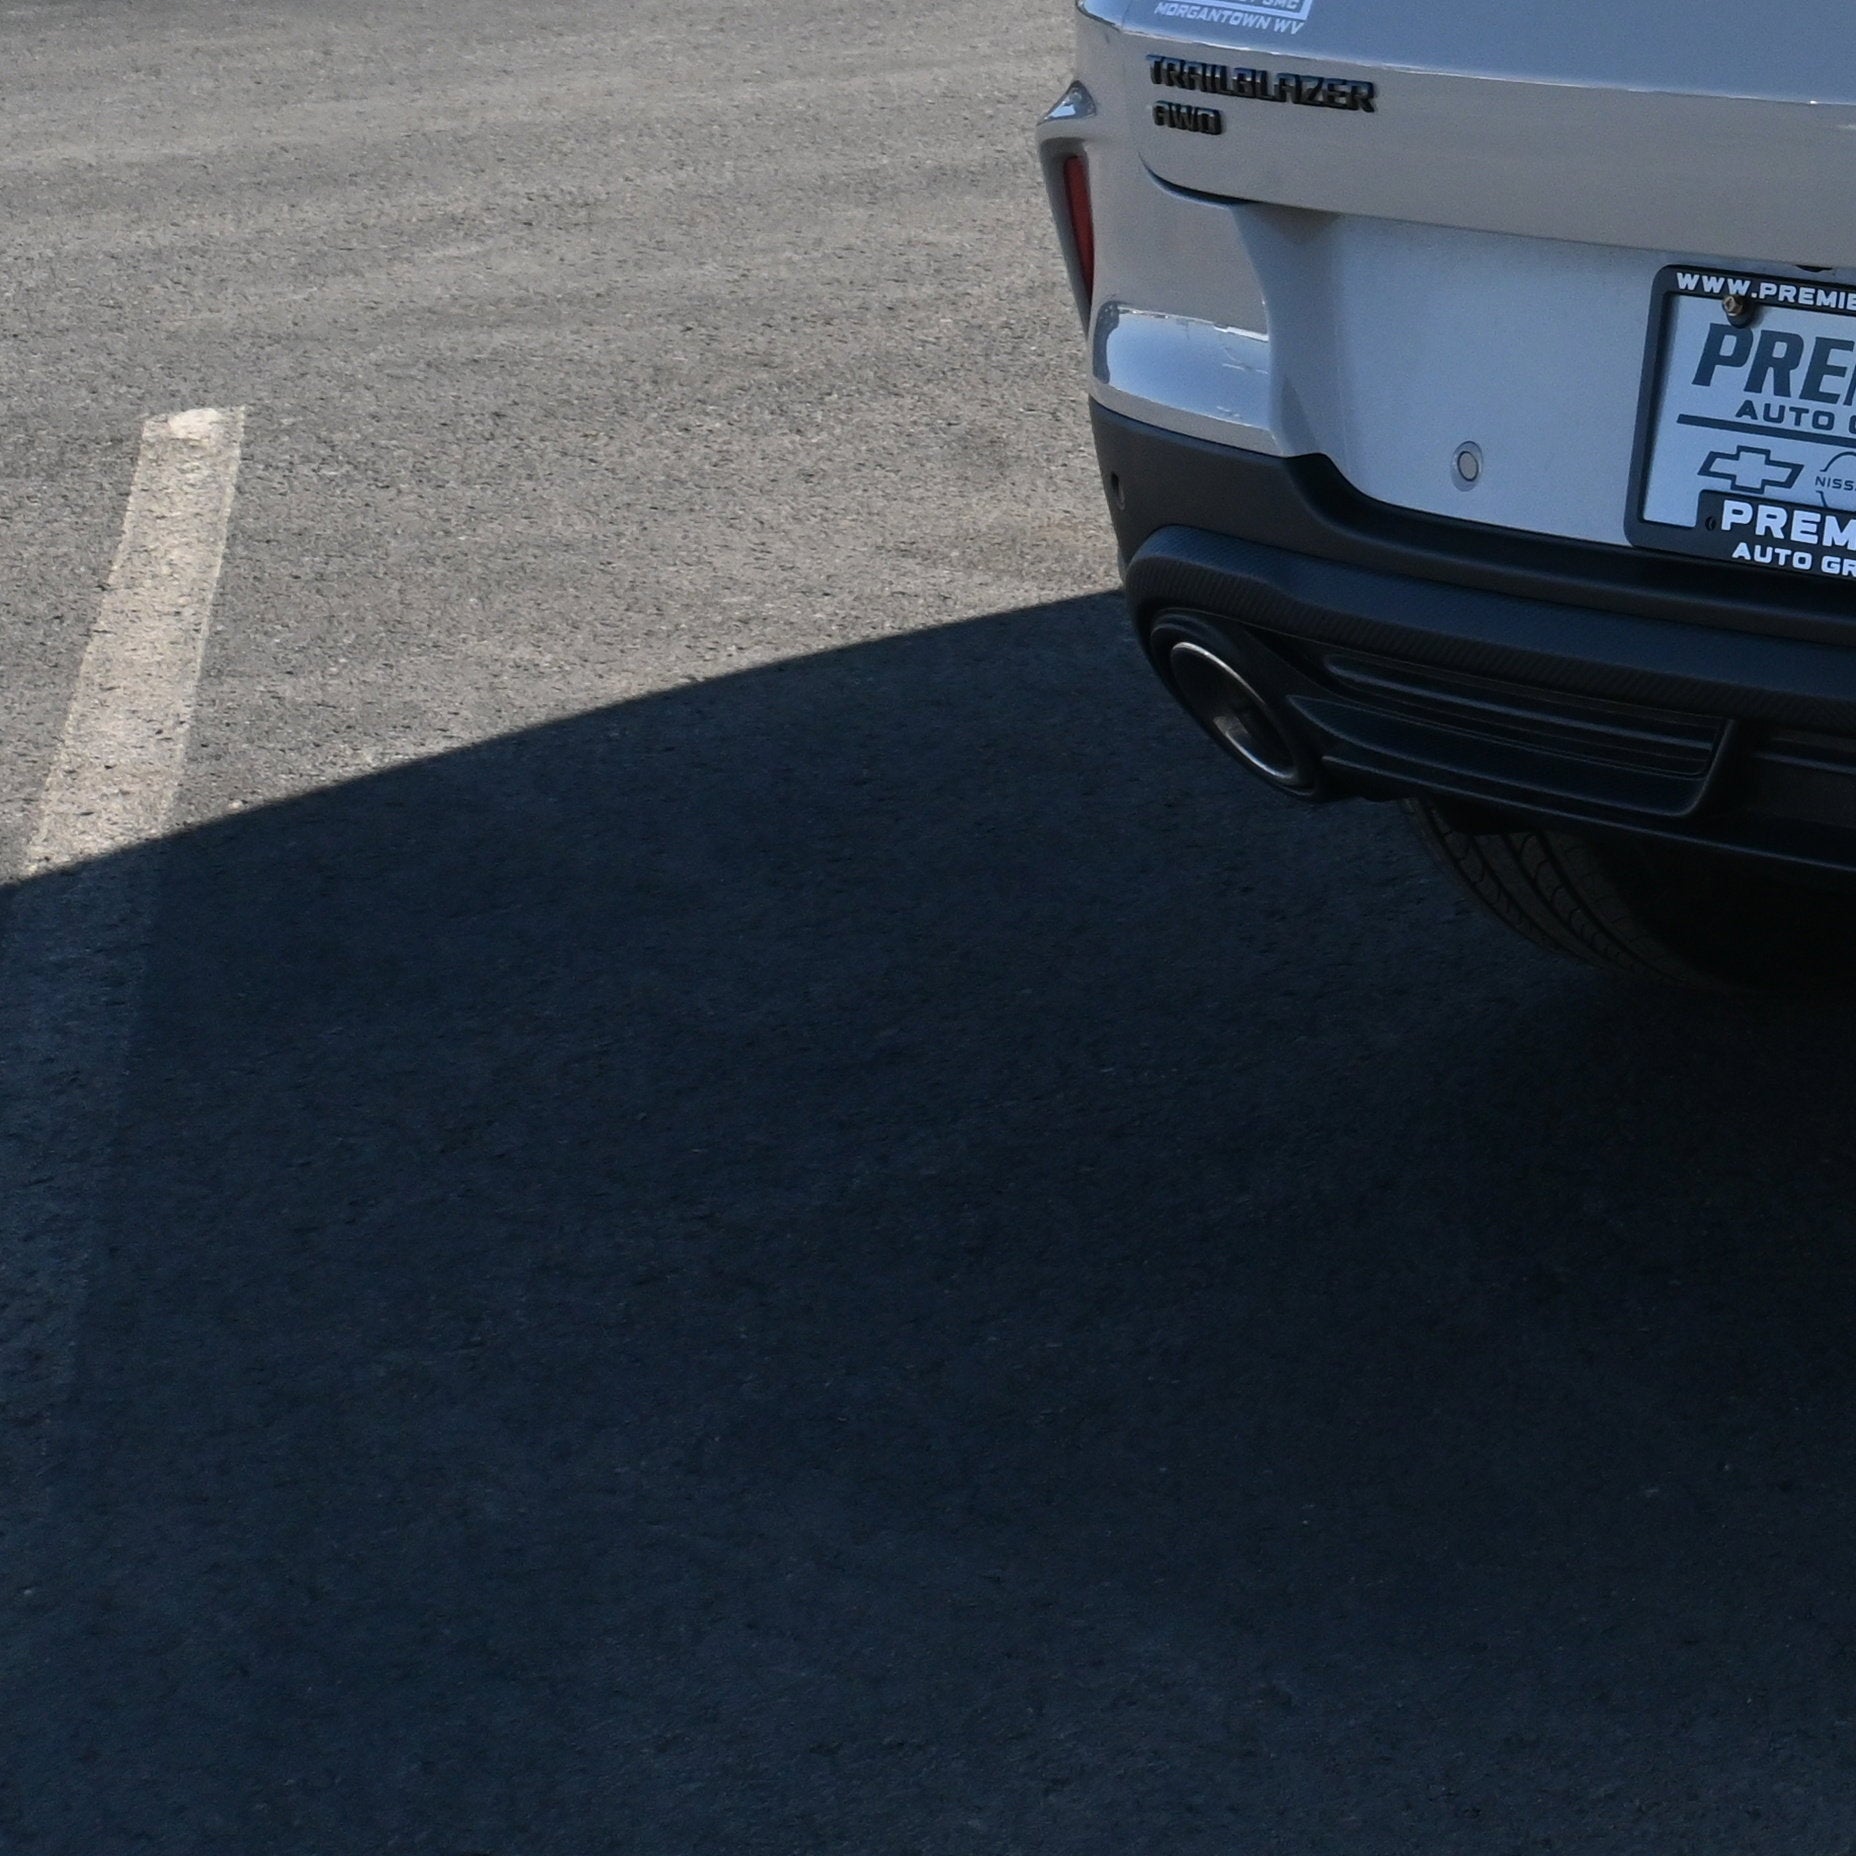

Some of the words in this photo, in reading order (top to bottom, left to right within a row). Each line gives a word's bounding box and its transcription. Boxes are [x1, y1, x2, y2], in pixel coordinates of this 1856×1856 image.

[1154, 1, 1273, 30] MORGANTOWN
[1272, 19, 1305, 35] WV
[1145, 53, 1378, 114] TRAILBLAZER
[1151, 99, 1224, 136] AWD
[1734, 399, 1836, 431] AUTO
[1731, 541, 1813, 571] AUTO
